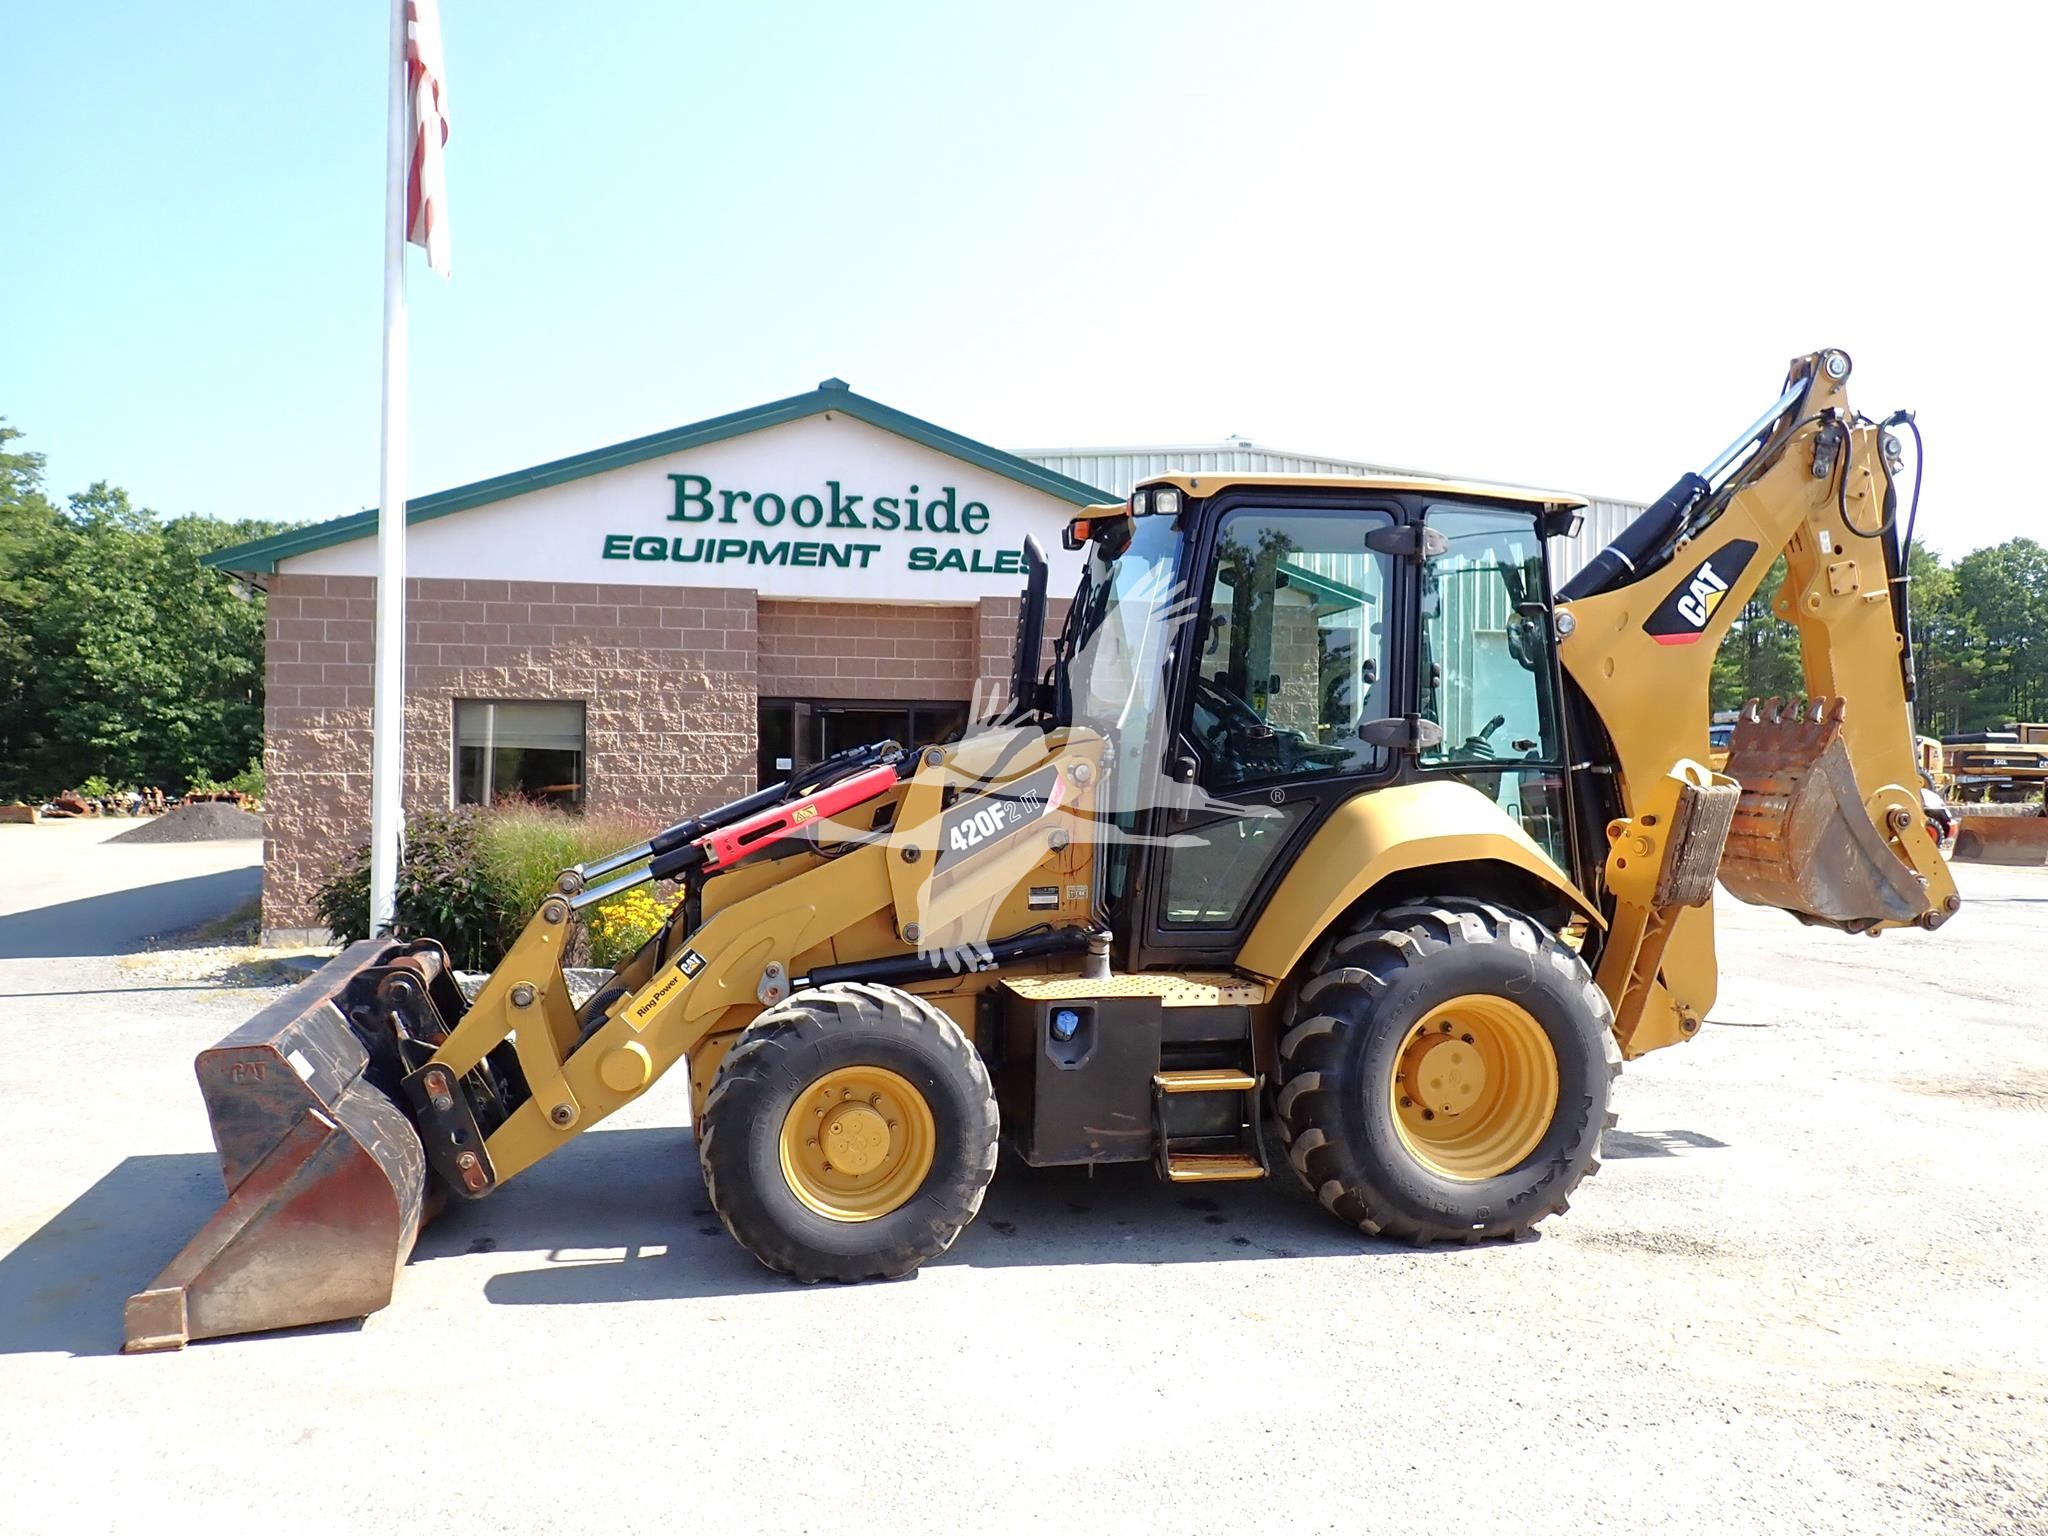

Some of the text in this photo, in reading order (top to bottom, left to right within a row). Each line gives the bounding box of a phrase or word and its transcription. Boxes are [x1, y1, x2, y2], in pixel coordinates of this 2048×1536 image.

[666, 473, 990, 535] Brookside
[601, 534, 881, 568] EQUIPMENT
[1677, 561, 1729, 627] CAT
[1020, 789, 1040, 814] IT
[636, 953, 701, 1018] Ring Power CAT
